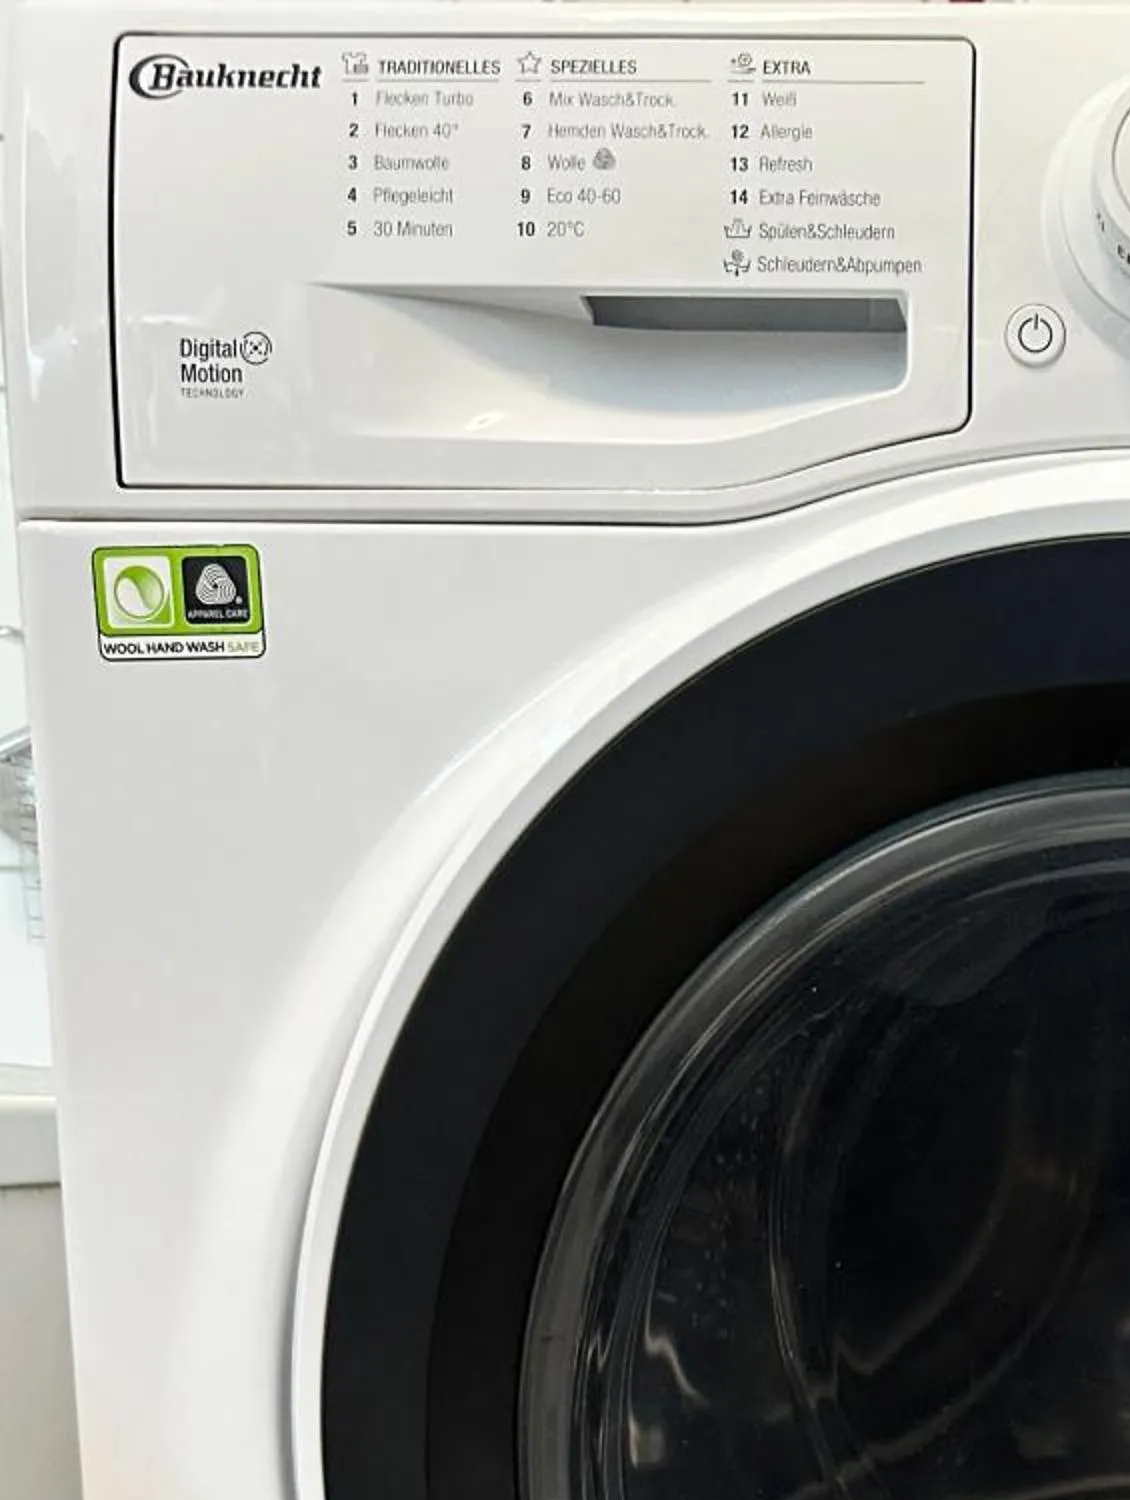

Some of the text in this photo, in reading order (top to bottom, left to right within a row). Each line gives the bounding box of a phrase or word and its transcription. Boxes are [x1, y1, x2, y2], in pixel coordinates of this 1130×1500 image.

[378, 59, 501, 75] TRADITIONELLES
[551, 59, 637, 74] SPEZIELLES
[763, 60, 811, 75] EXTRA
[132, 56, 323, 96] Bauknecht
[352, 91, 474, 106] 1 Flecken Turbo
[523, 91, 533, 106] 6
[549, 92, 573, 107] Mix
[732, 92, 749, 107] 11
[349, 123, 359, 138] 2
[375, 123, 428, 138] Flecken
[521, 124, 532, 139] 7
[549, 123, 606, 139] Hemden
[731, 124, 813, 141] 12 Allergie
[348, 154, 449, 170] 3 Baumwolle
[521, 155, 586, 171] 8 Wolle
[731, 156, 813, 172] 13 Refresh
[347, 187, 453, 206] 4 Pflegeleicht
[520, 188, 621, 204] 9 Eco 40-60
[730, 189, 881, 207] 14 Extra Feinwäsche
[347, 220, 453, 236] 5 30 Minuten
[517, 220, 585, 237] 10 20°C
[759, 222, 895, 241] Spülen&Schleudern
[757, 255, 922, 277] Schleudern&Abpumpen
[180, 338, 237, 361] Digital
[181, 363, 243, 383] Motion
[103, 641, 259, 655] WOOL HAND WASH SAFE
